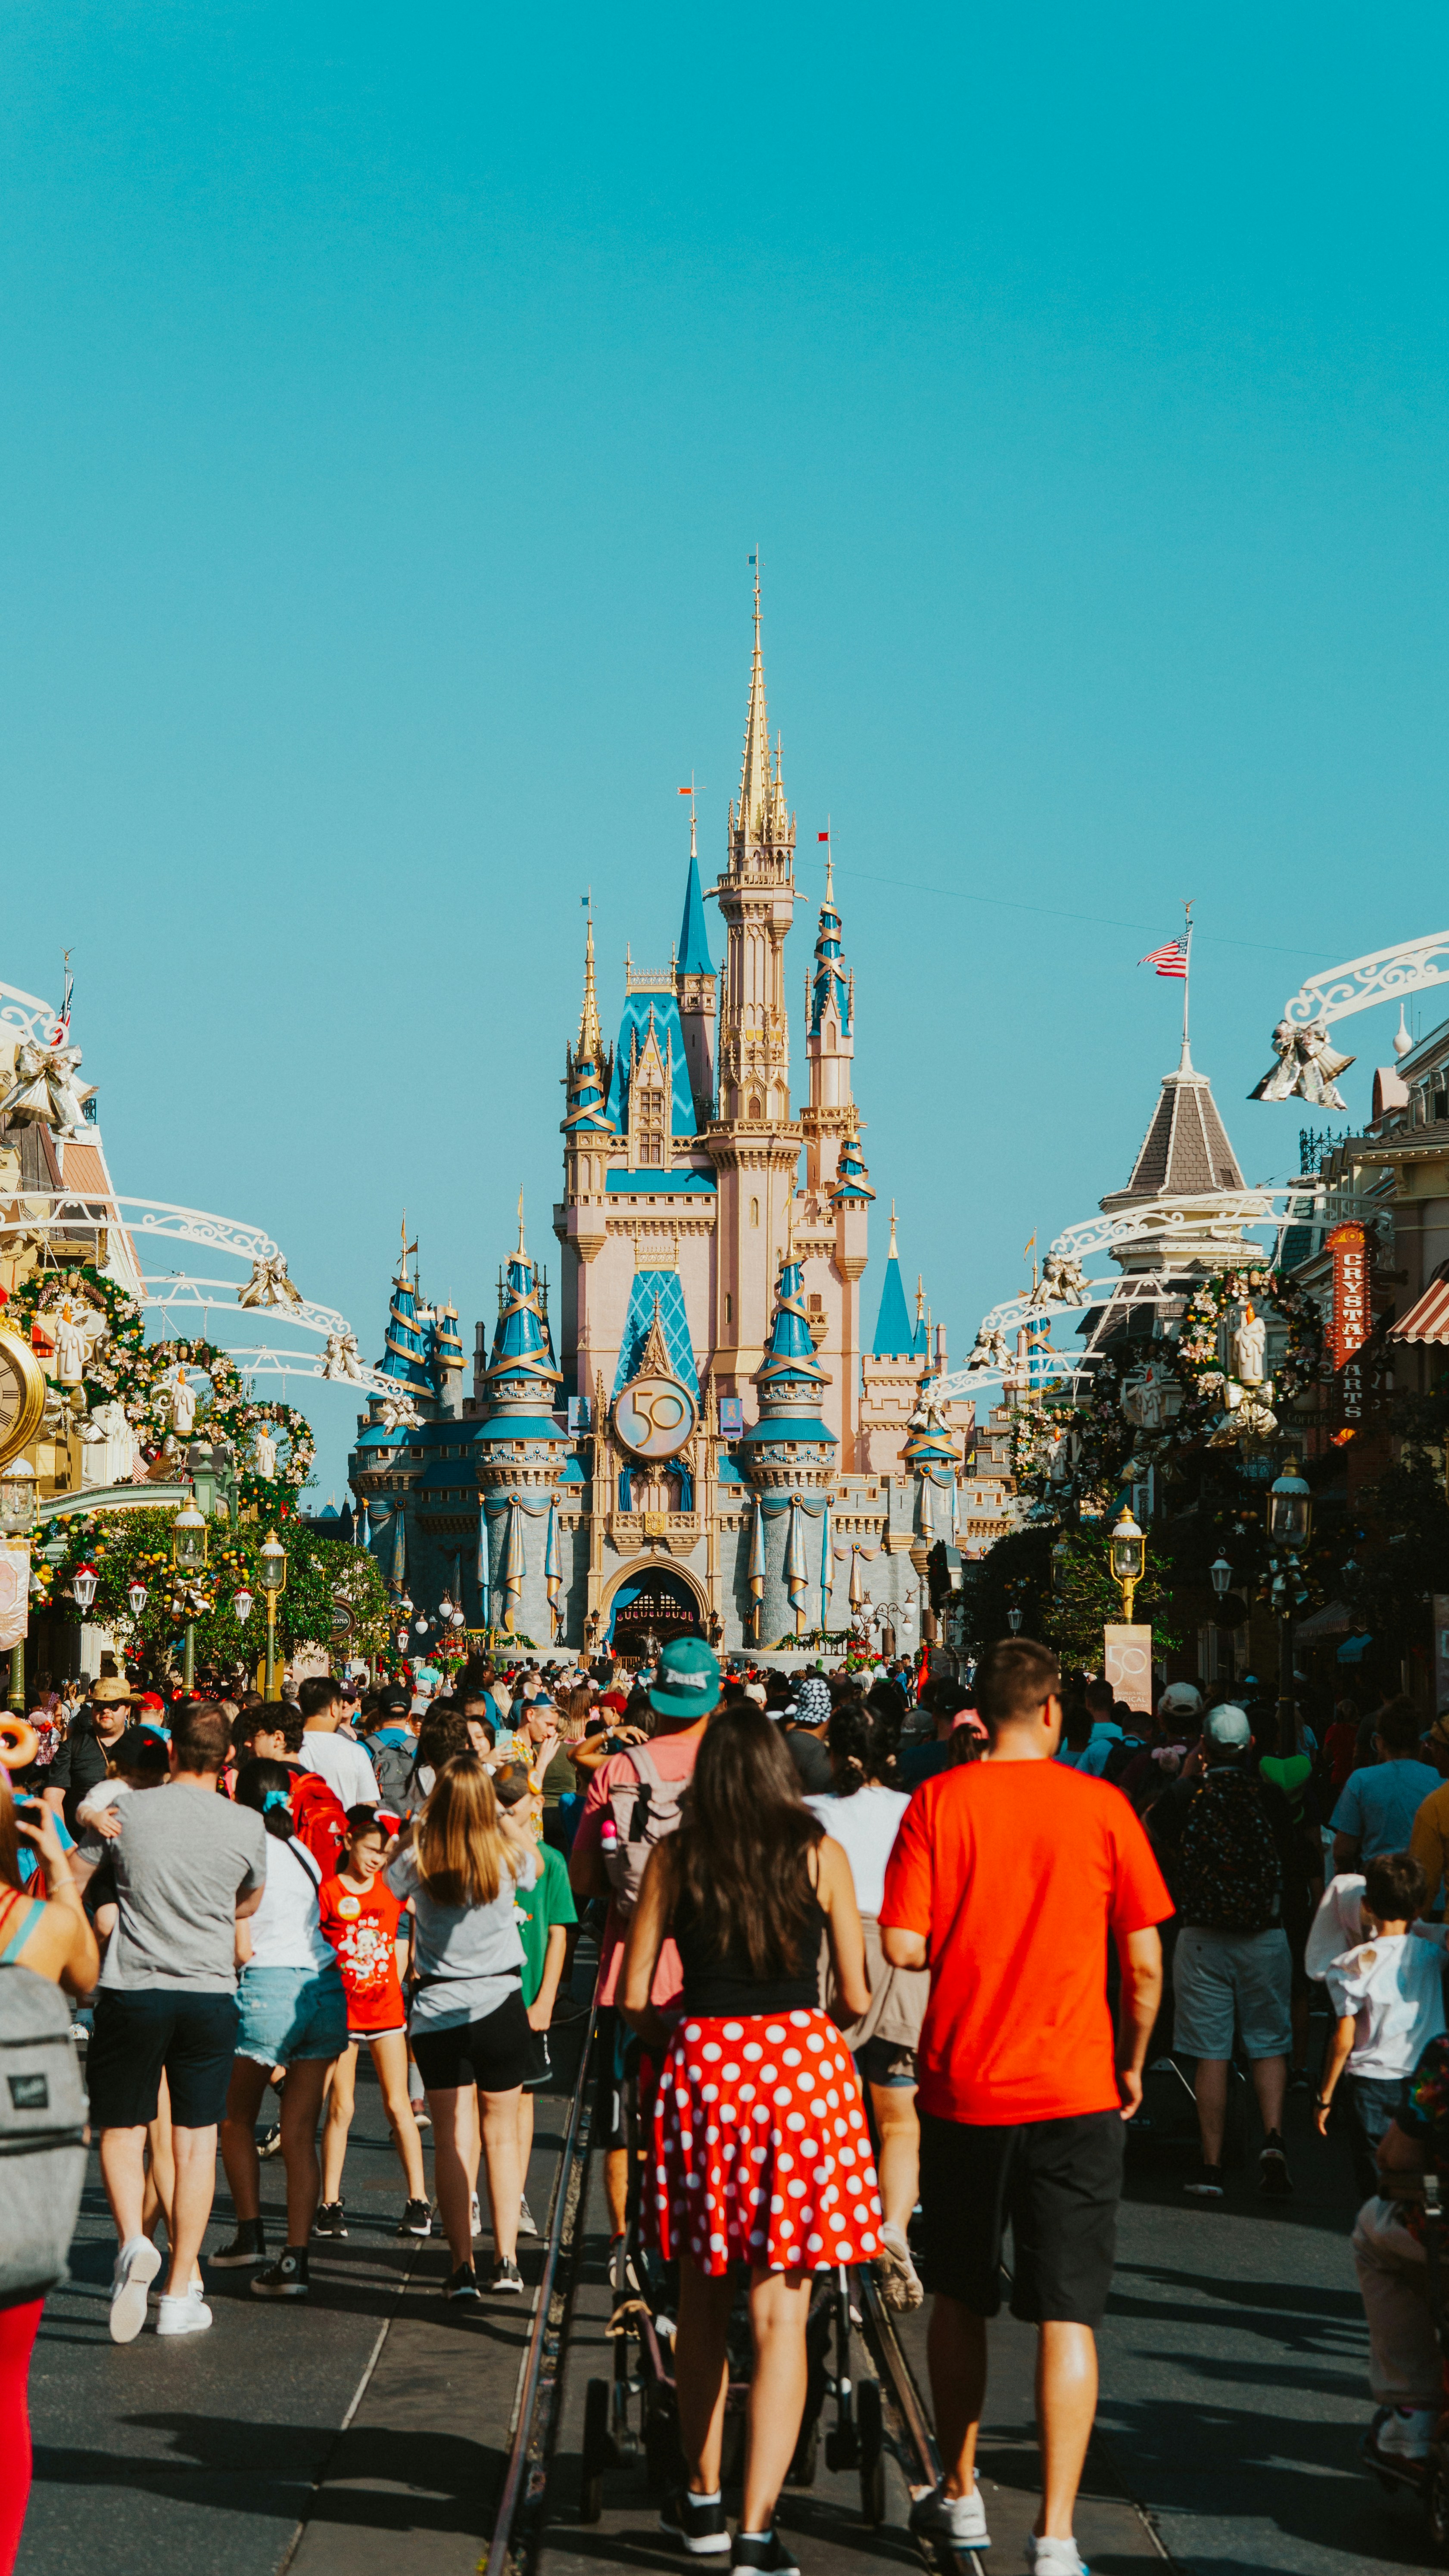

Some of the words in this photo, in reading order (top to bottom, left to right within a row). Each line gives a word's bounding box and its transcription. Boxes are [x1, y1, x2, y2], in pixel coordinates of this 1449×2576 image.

[1342, 1254, 1363, 1349] CRYSTAL
[1343, 1364, 1362, 1418] ARTS
[634, 1391, 685, 1447] 50
[1287, 1413, 1326, 1424] COFFEE
[1109, 1646, 1147, 1687] 50
